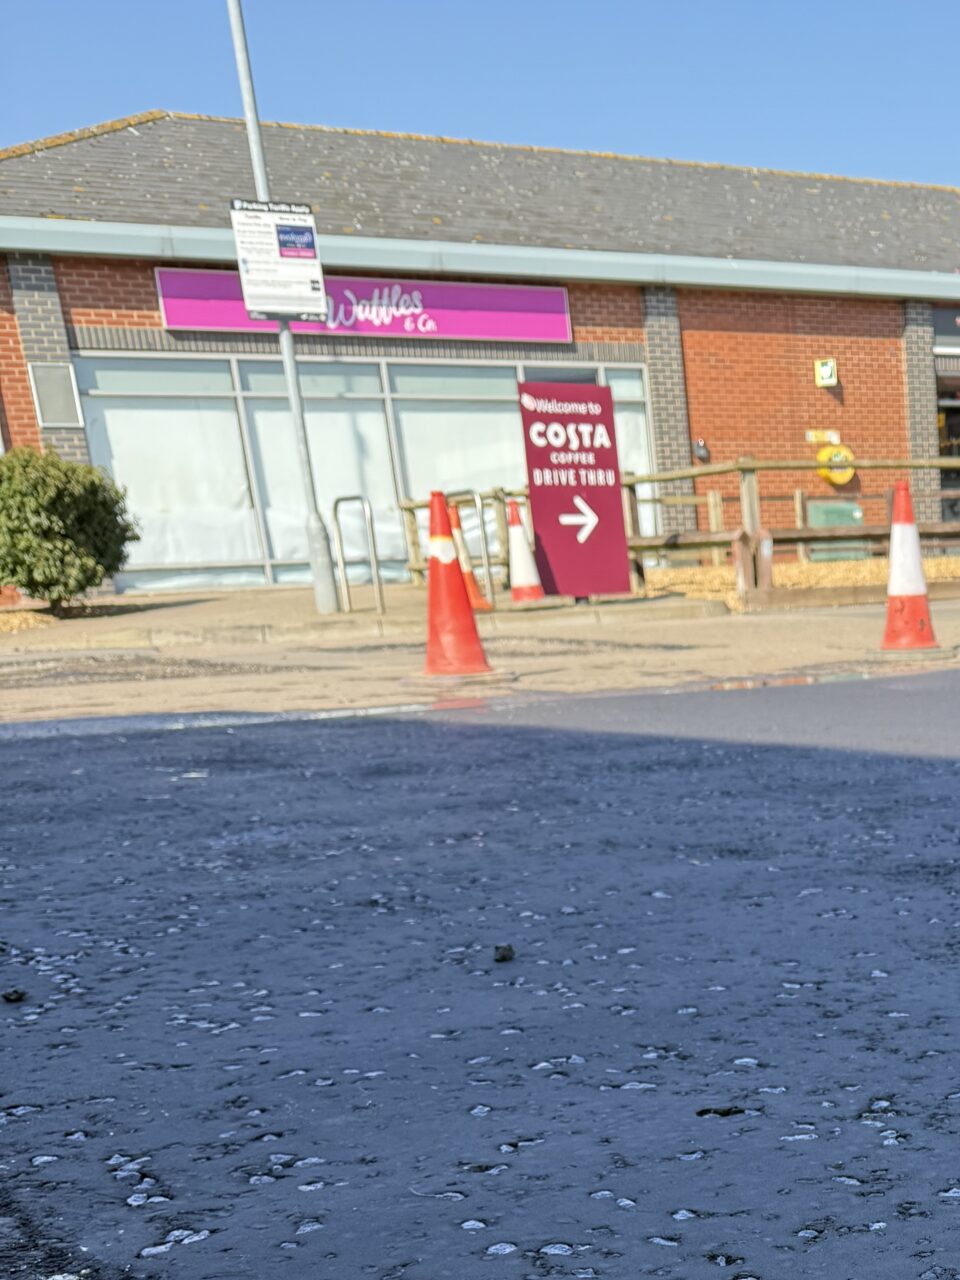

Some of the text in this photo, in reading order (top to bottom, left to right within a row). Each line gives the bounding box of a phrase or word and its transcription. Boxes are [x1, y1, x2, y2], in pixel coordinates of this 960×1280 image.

[326, 284, 423, 329] Waffles
[535, 398, 602, 415] Welcome to
[529, 421, 612, 451] COSTA
[549, 451, 596, 464] COFFEE
[532, 468, 615, 486] DRIVE THRU
